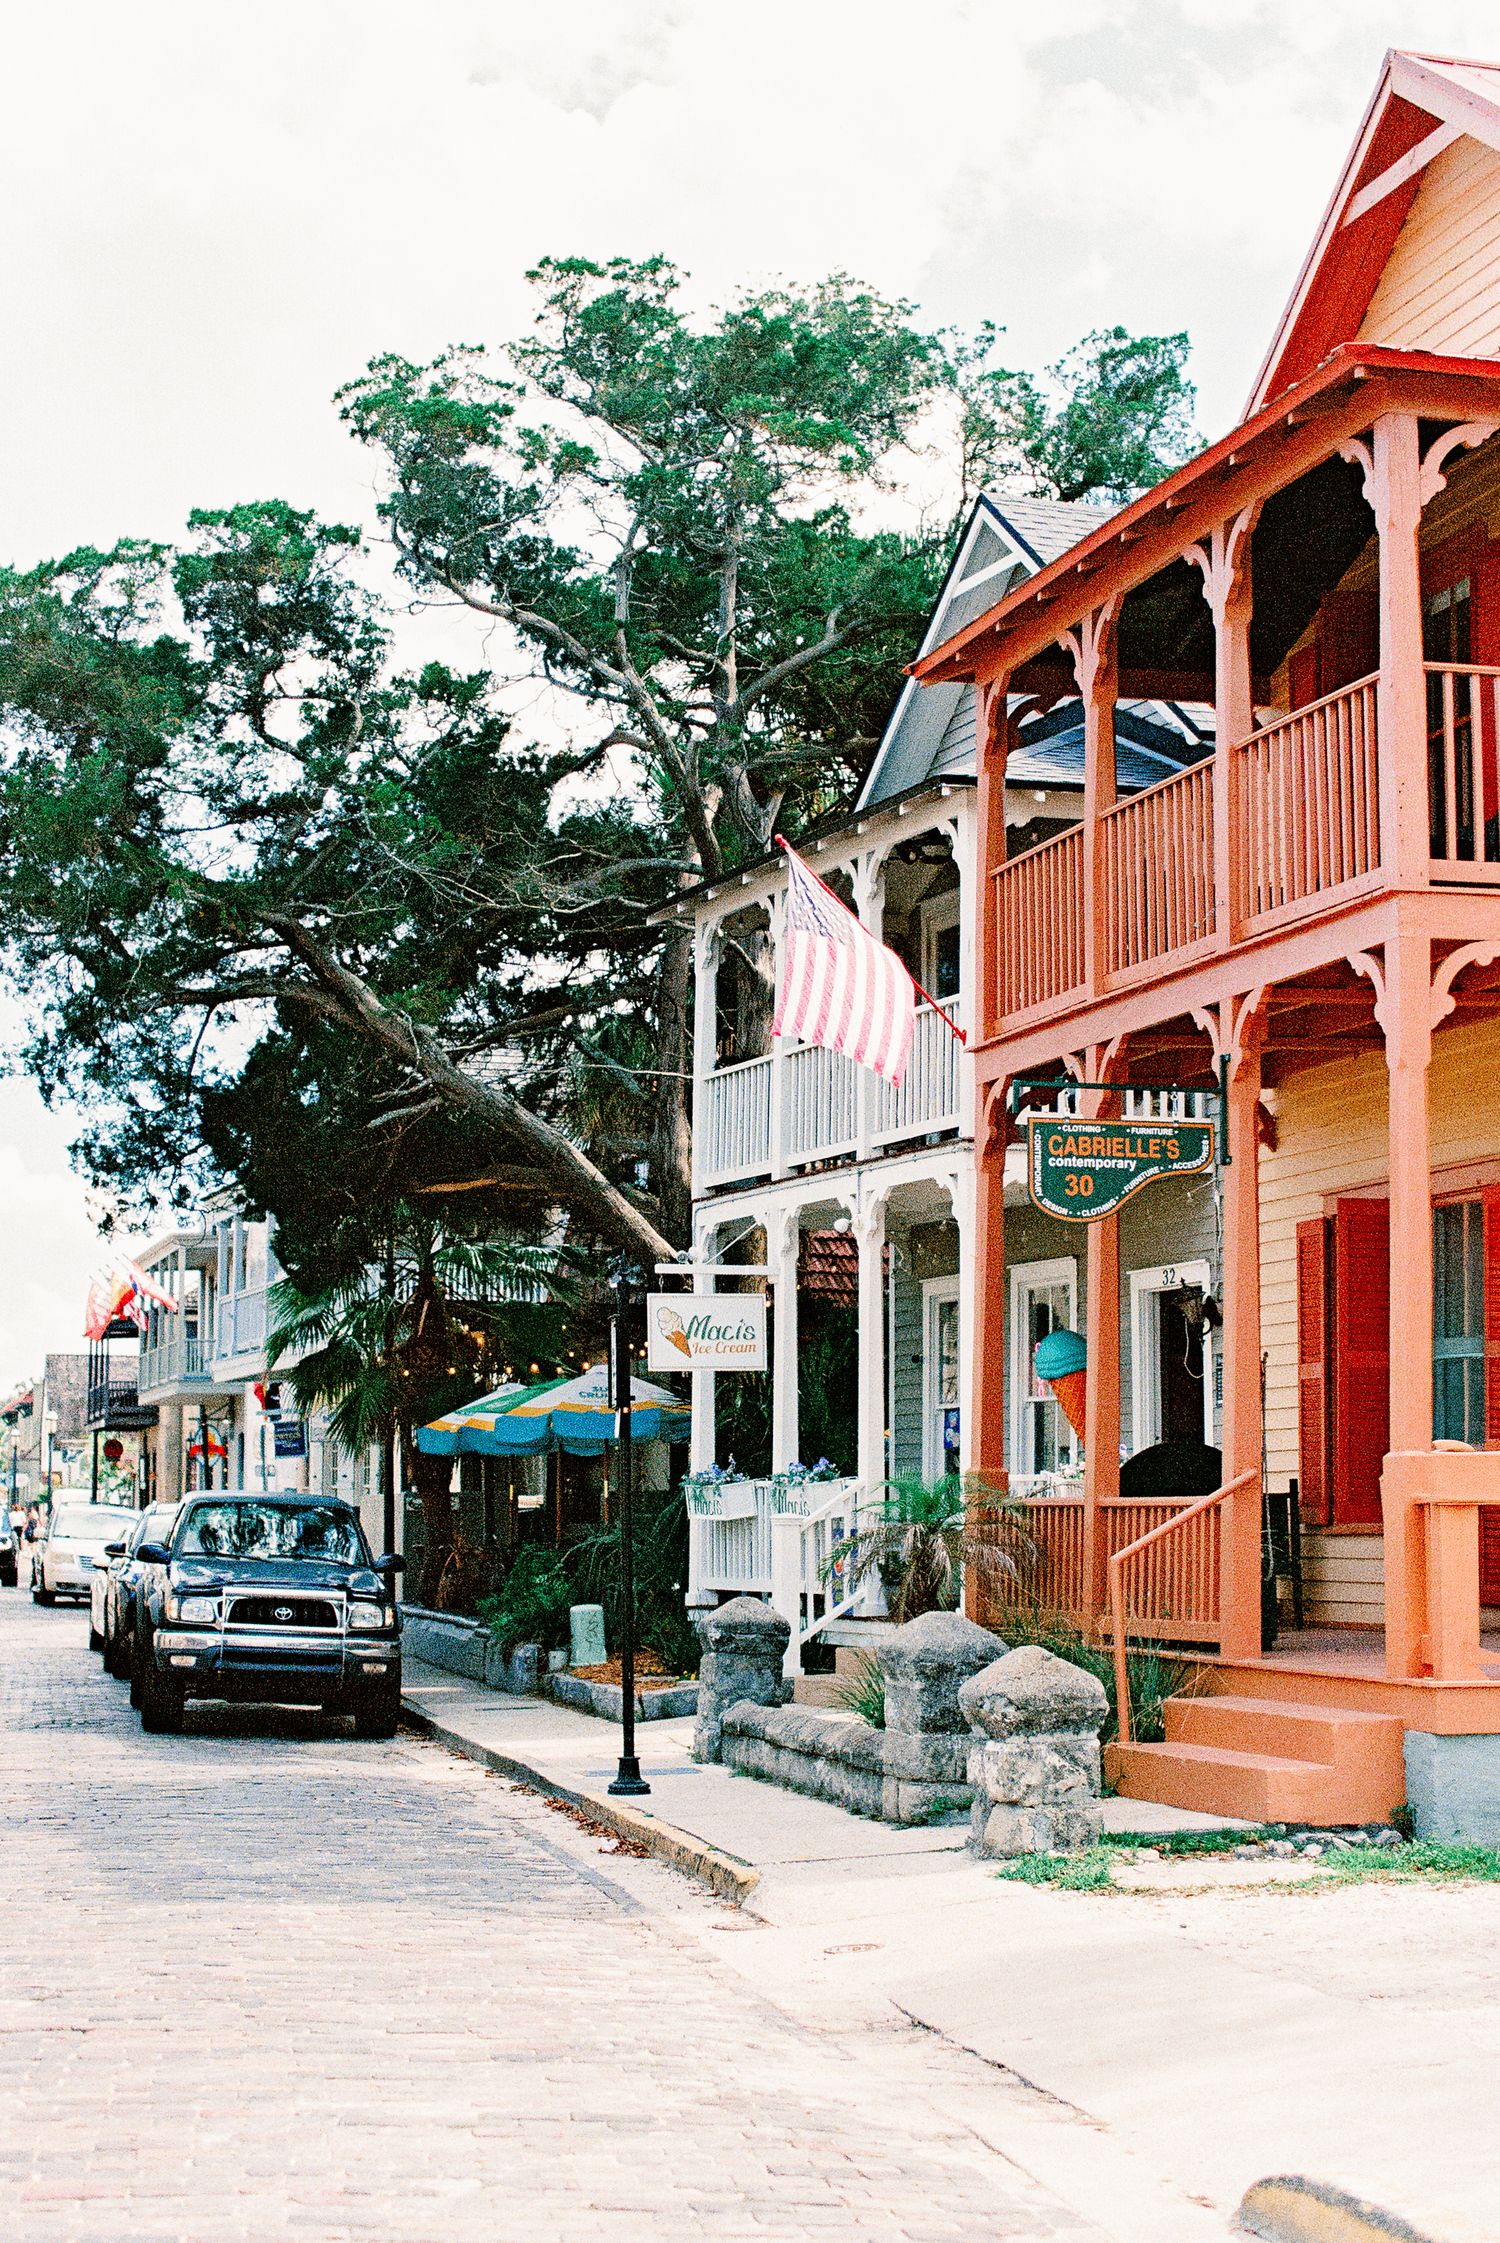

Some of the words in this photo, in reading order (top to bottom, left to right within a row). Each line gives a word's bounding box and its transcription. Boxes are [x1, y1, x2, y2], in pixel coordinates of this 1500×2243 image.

[1062, 1124, 1101, 1133] CLOTHING
[1130, 1127, 1174, 1136] FURNITURE
[1048, 1134, 1181, 1160] GABRIELLE'S
[1172, 1139, 1209, 1170] ACCESSORIES
[1048, 1155, 1137, 1172] contemporary
[1034, 1133, 1043, 1197] CONTEMPORARY
[1041, 1197, 1068, 1216] DESIGN
[1123, 1165, 1160, 1193] FURNITURE
[1064, 1173, 1095, 1197] 30
[1081, 1198, 1117, 1217] CLOTHING
[1162, 1267, 1176, 1286] 32
[692, 1342, 712, 1354] Ice
[715, 1341, 757, 1354] Cream
